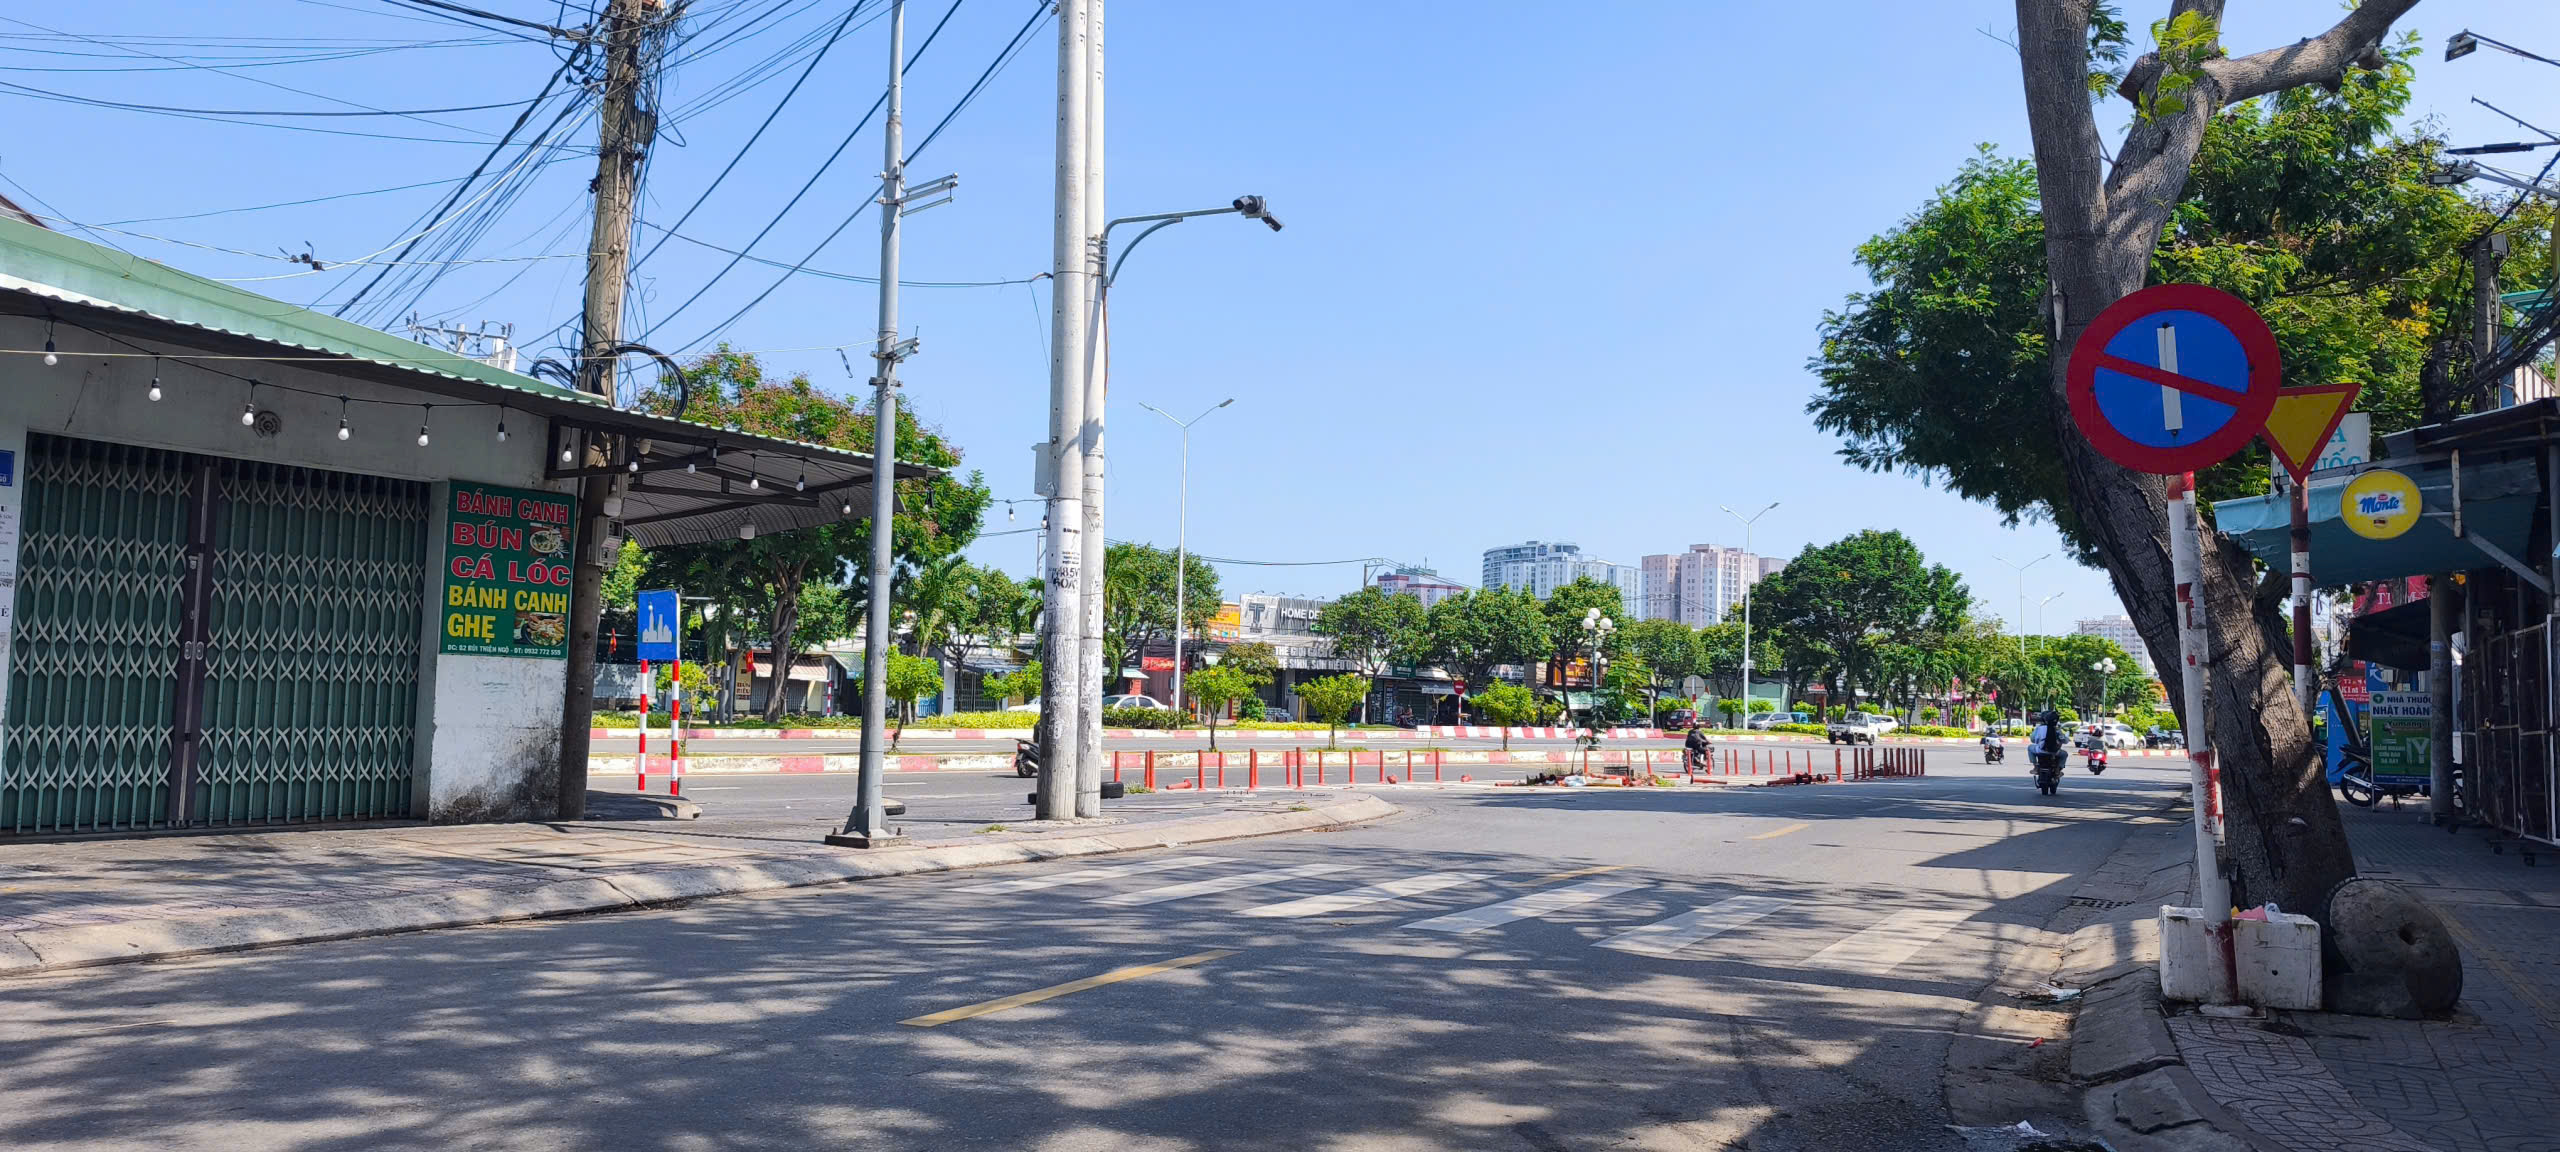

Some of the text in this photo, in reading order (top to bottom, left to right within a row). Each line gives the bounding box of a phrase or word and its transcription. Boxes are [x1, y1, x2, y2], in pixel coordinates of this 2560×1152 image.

[457, 488, 568, 524] BÁNH CANH
[2360, 496, 2400, 514] Monte
[452, 520, 522, 550] BÚN
[451, 553, 570, 587] CÁ LÓC
[448, 581, 567, 613] BÁNH CANH
[447, 613, 496, 644] GHẸ
[1281, 608, 1307, 619] HOME
[2372, 704, 2399, 717] NHẬT
